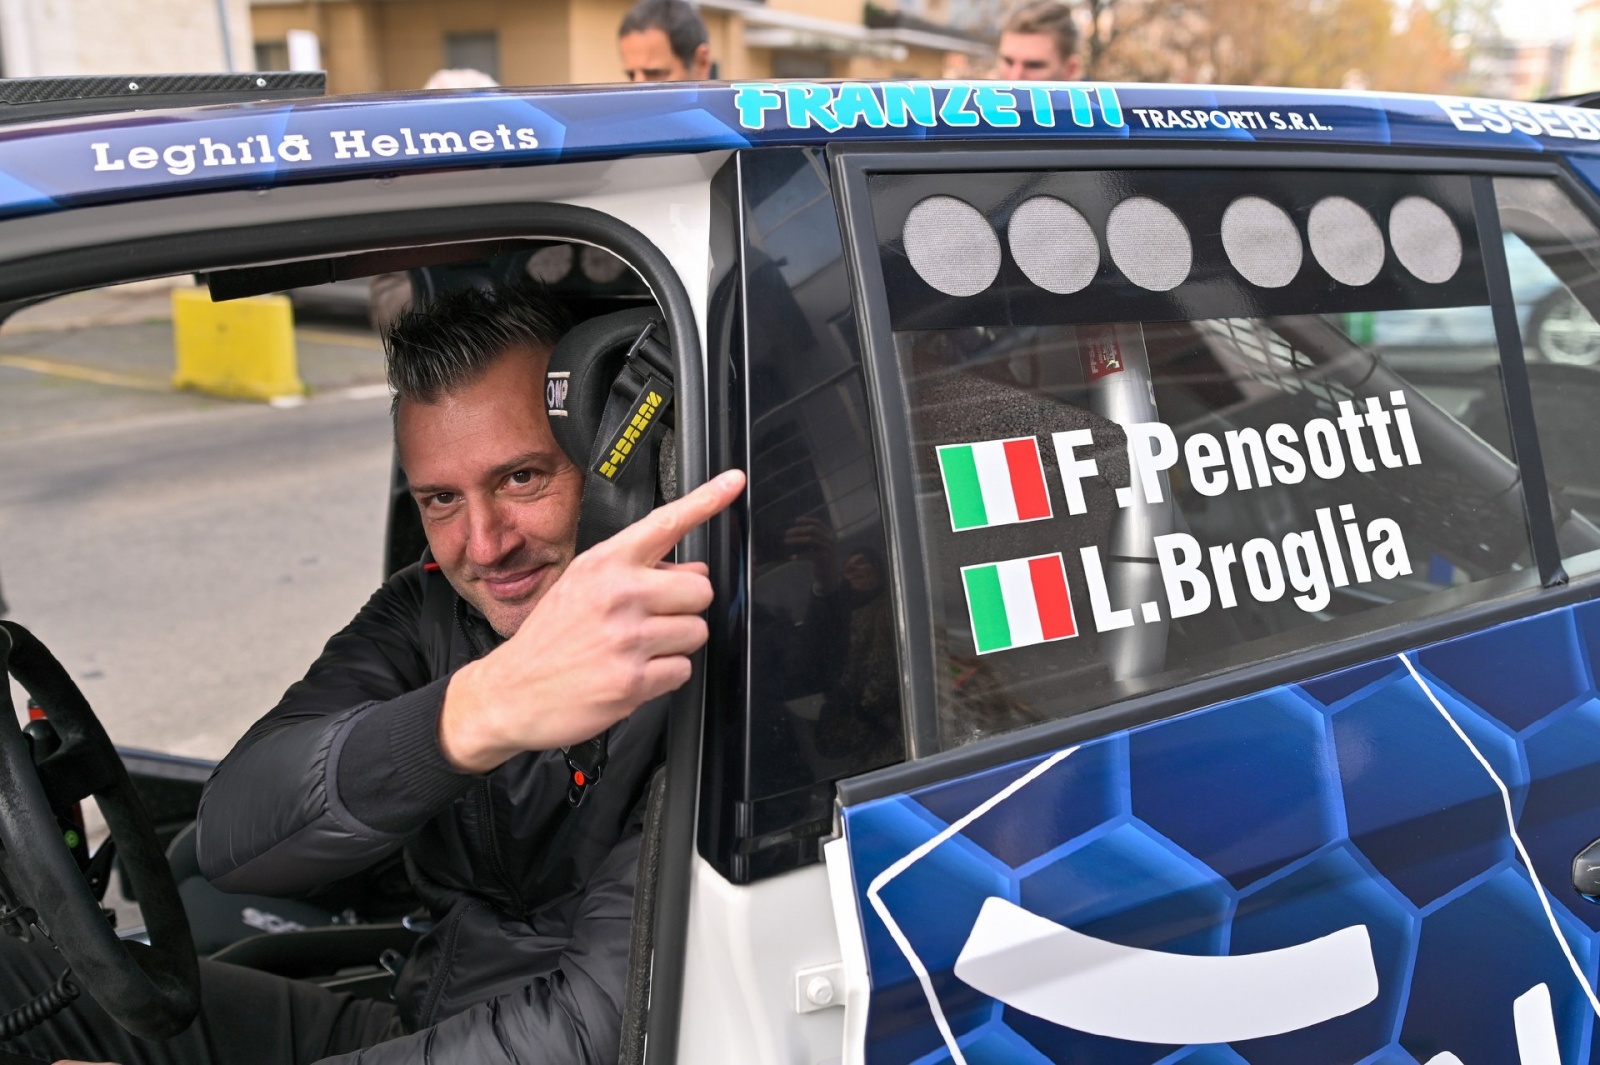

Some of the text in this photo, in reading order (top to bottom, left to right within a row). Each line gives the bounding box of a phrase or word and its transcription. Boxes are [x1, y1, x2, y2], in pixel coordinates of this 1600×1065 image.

[731, 81, 1333, 133] FRANZETTI TRASPORTI S.R.L.
[1436, 99, 1600, 141] ESSEB
[330, 124, 539, 160] Helmets
[546, 379, 569, 409] OMP
